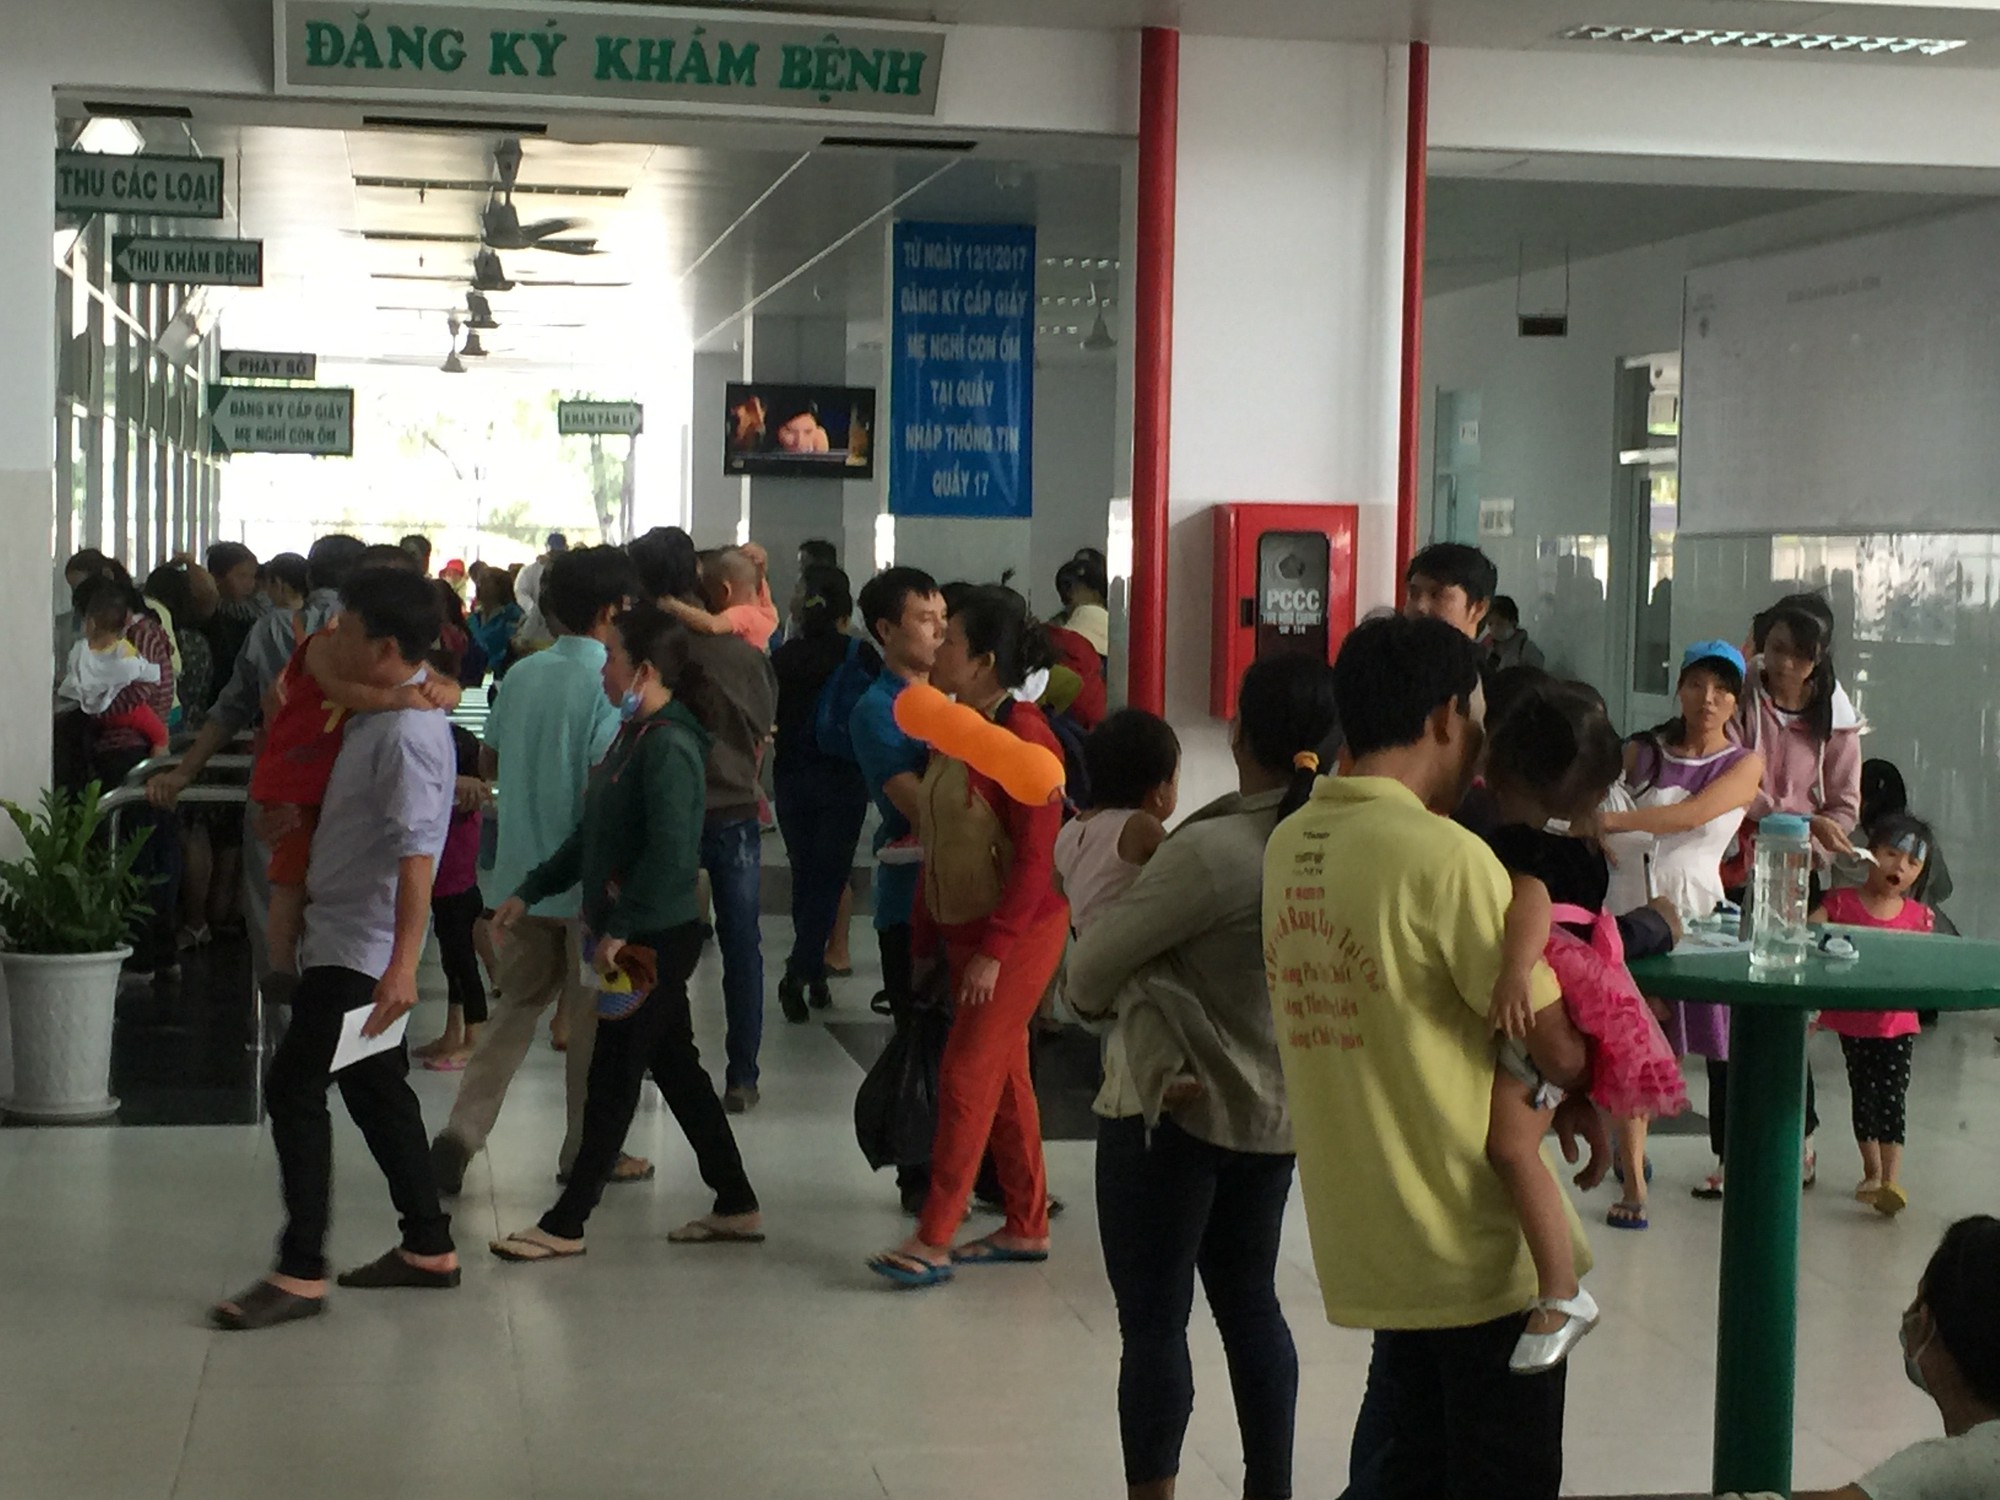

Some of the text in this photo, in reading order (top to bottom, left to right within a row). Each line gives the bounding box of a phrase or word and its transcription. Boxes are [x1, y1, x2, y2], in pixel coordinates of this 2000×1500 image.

[305, 6, 927, 102] ĐĂNG KÝ KHÁM BỆNH
[59, 163, 215, 210] THU CÁC LOẠI
[129, 245, 257, 281] THU KHÁM BỆNH
[968, 333, 996, 361] CON
[931, 379, 953, 413] TẠI
[974, 471, 989, 497] 17
[1266, 589, 1320, 611] PCCC
